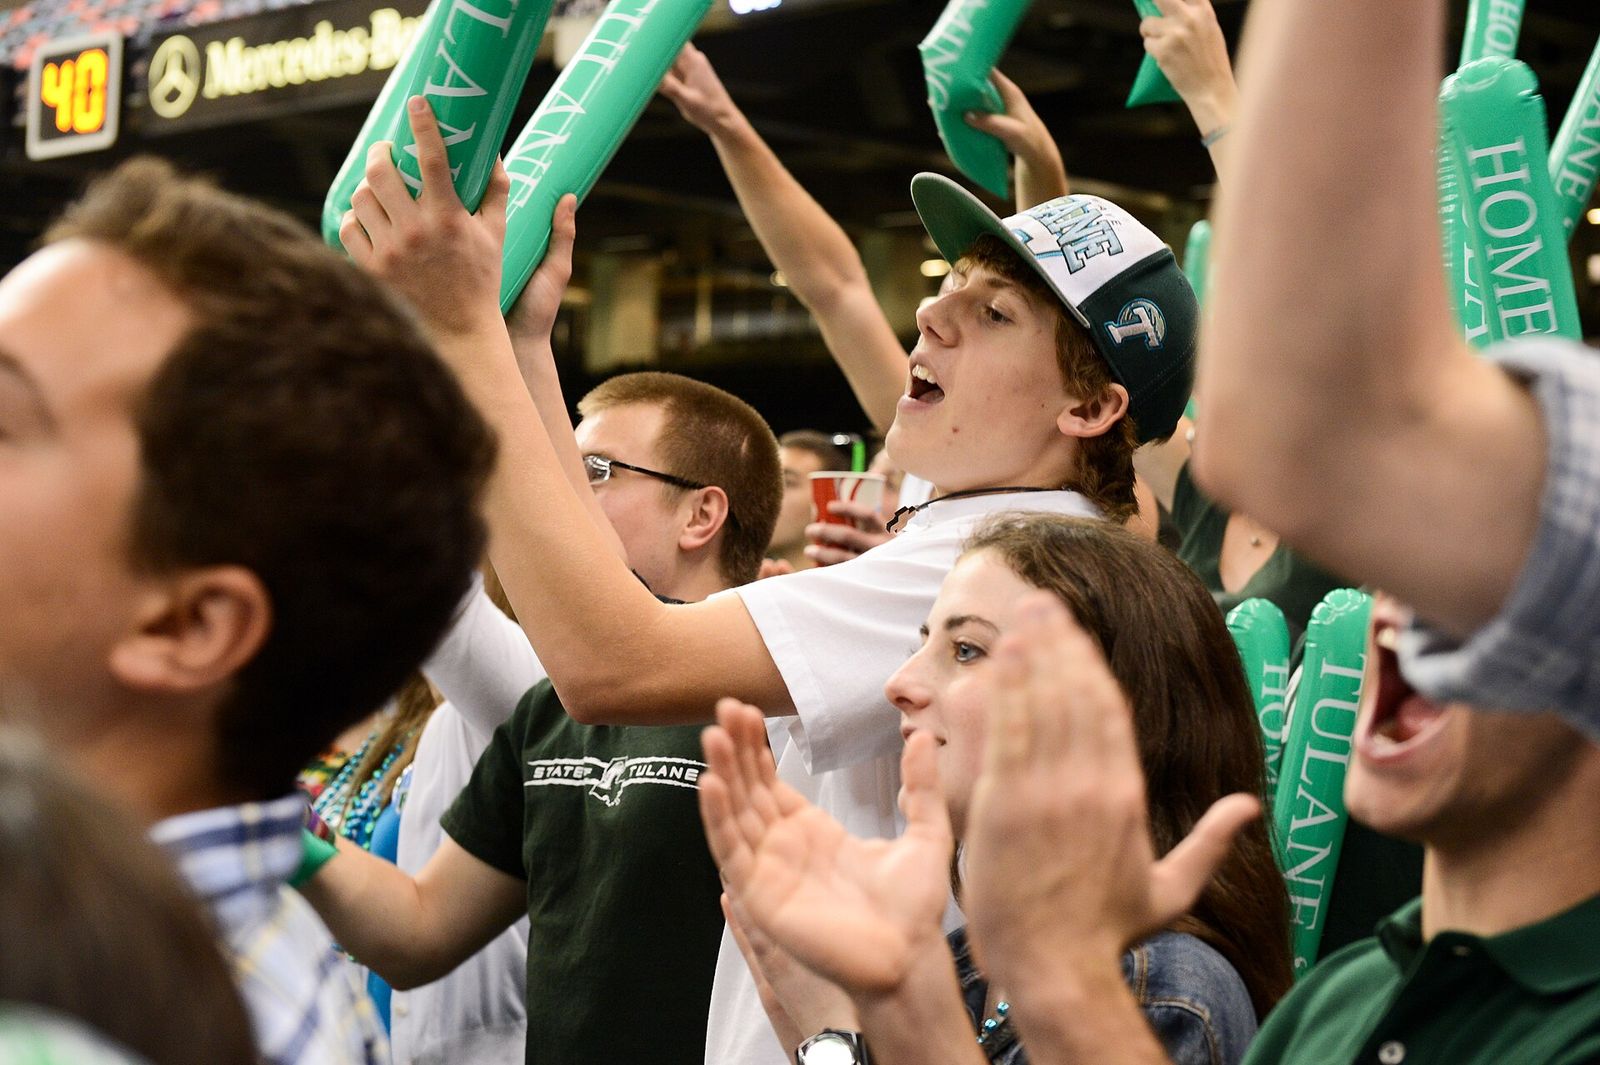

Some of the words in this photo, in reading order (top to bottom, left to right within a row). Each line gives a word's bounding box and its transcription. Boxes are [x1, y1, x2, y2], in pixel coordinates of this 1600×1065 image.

[1483, 0, 1524, 58] HO
[41, 48, 110, 134] 40
[1467, 135, 1560, 343] HOME
[533, 766, 584, 778] STATE
[629, 764, 700, 781] TULANE
